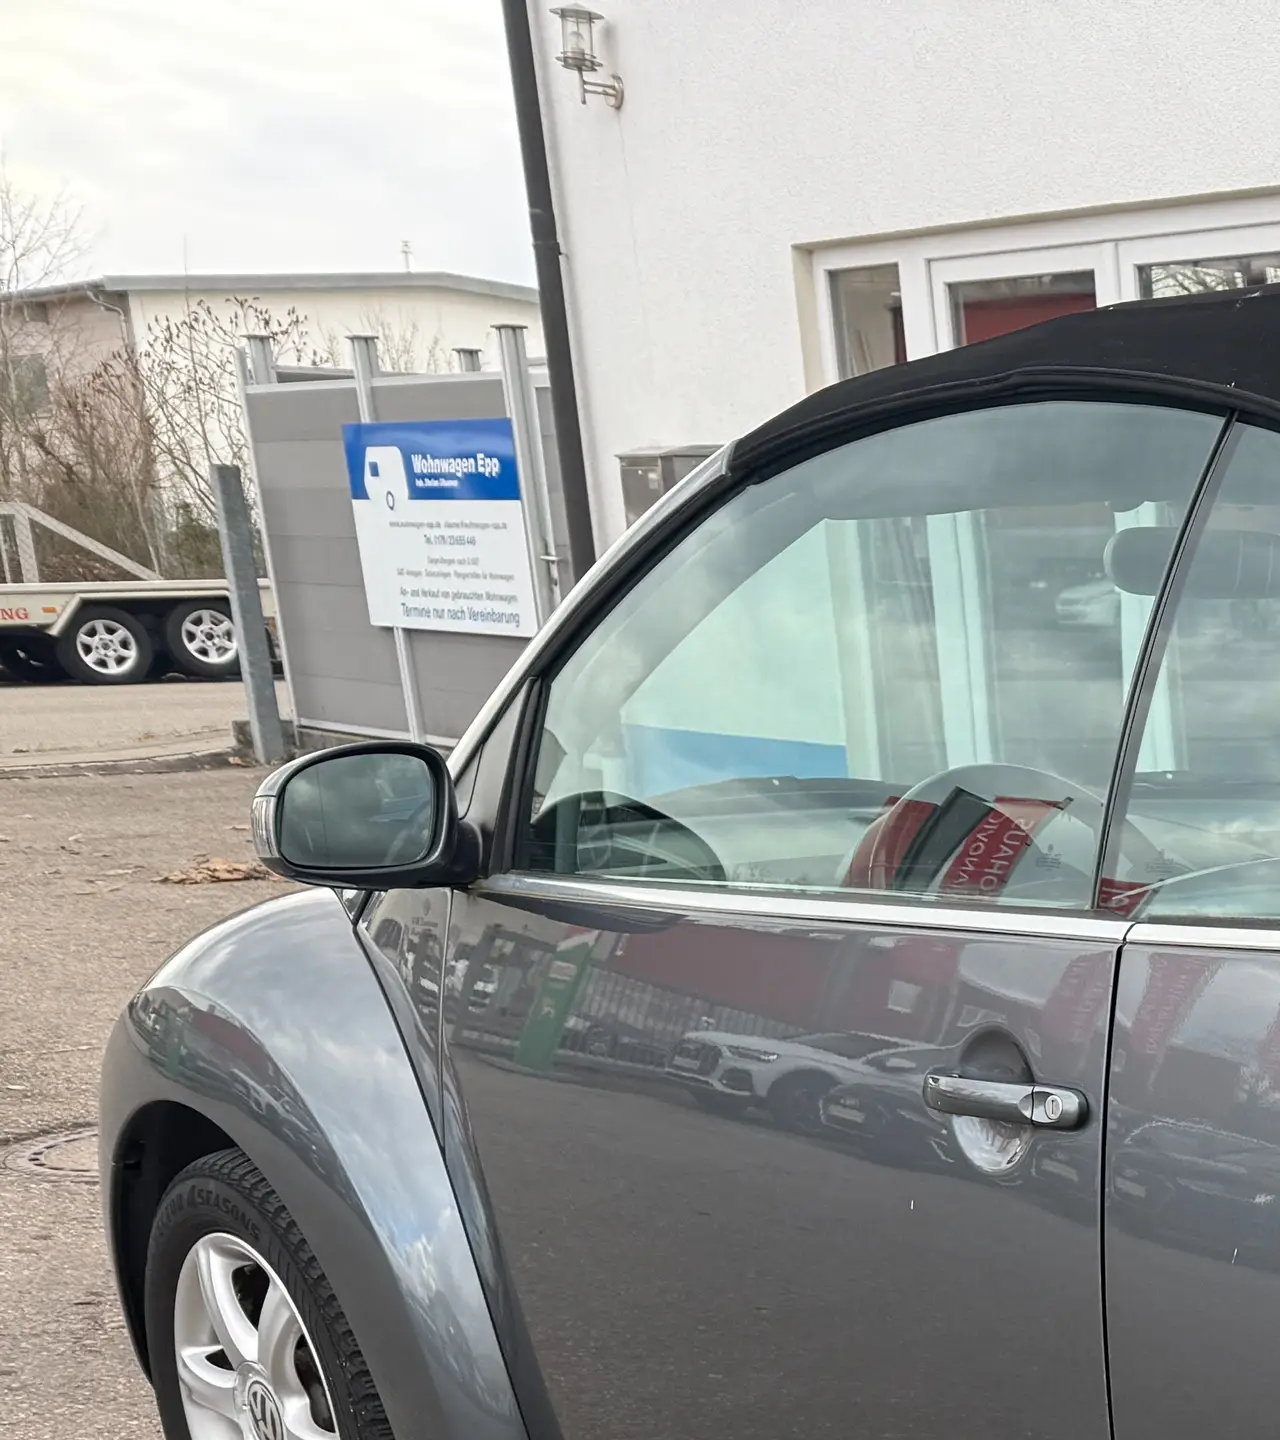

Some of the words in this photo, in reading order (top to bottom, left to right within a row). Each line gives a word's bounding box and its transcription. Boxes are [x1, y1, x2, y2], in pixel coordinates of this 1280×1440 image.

[411, 453, 476, 477] Wohnwagen
[477, 453, 500, 478] Epp
[401, 602, 431, 619] Termine
[432, 607, 446, 619] nur
[447, 605, 466, 621] nach
[467, 606, 520, 628] Vereinbarung
